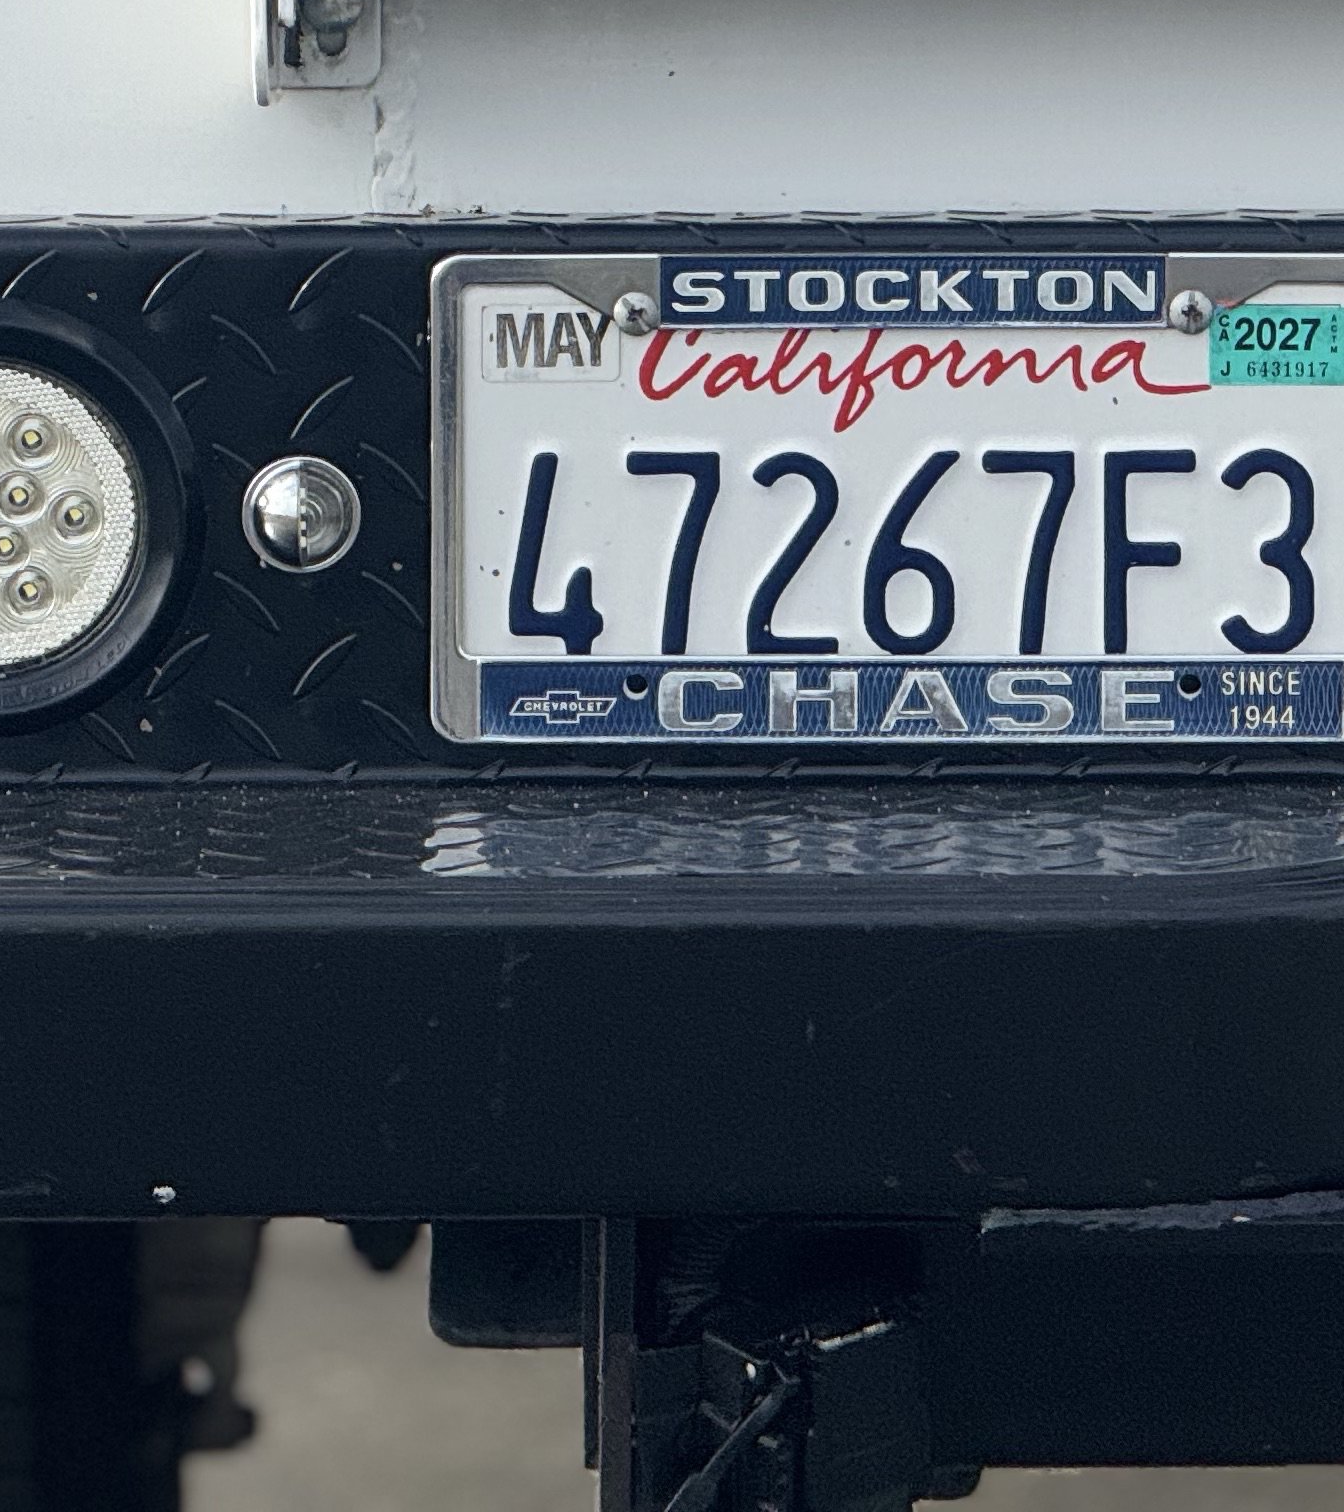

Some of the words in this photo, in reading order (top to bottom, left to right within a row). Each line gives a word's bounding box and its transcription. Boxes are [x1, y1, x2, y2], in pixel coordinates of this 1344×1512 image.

[671, 269, 1156, 313] STOCKTON
[496, 311, 612, 368] MAY
[1234, 317, 1321, 351] 2027
[639, 328, 1209, 432] California
[1220, 360, 1231, 377] J
[1246, 361, 1329, 378] 6431917
[508, 448, 1315, 656] 47267F3
[657, 670, 1177, 733] CHASE
[1222, 671, 1301, 696] SINCE
[523, 701, 603, 712] CHEVROLET
[1230, 705, 1296, 730] 1944
